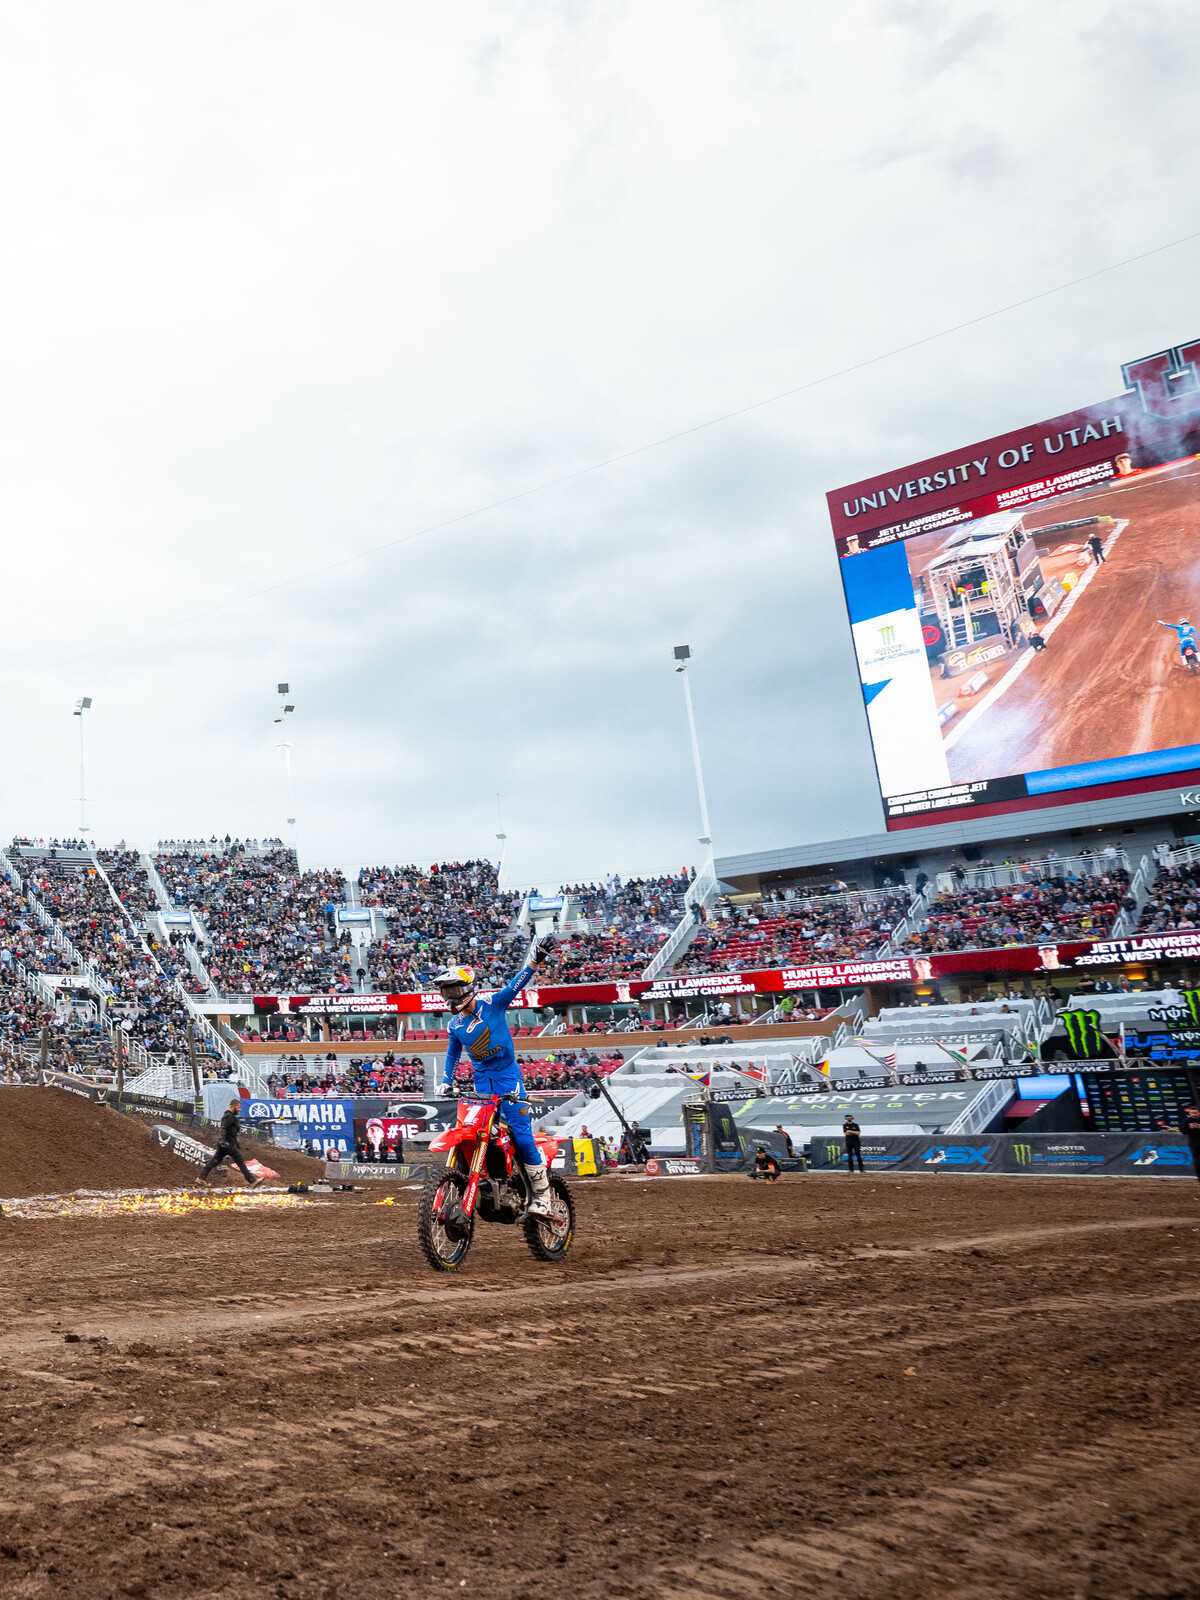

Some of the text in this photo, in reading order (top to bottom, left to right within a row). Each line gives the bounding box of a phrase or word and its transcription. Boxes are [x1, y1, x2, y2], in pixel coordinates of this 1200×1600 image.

[843, 414, 1124, 517] UNIVERSITY OF UTAH
[997, 462, 1112, 502] HUNTER LAWRENCE
[998, 469, 1114, 508] 250SX EAST CHAMPION
[878, 507, 960, 538] JETT LAWRENCE
[897, 526, 921, 542] WEST
[921, 511, 973, 534] CHAMPION
[1090, 941, 1129, 954] JETT
[1074, 954, 1120, 966] 250SX
[1121, 950, 1163, 962] WEST
[782, 959, 910, 980] HUNTER LAWRENCE
[60, 977, 72, 986] 41
[513, 971, 529, 992] HONDA
[651, 975, 742, 991] JETT LAWRENCE
[783, 970, 912, 990] 250SX EAST CHAMPION
[421, 994, 446, 1003] HUN
[641, 984, 755, 1000] 250SX WEST CHAMPION
[299, 1003, 398, 1013] 250SX WEST CHAMPION
[308, 995, 387, 1006] JETT LAWRENCE
[474, 1045, 503, 1061] HONDA
[767, 1090, 968, 1105] MONSTER
[135, 1106, 174, 1119] MONSTER
[270, 1104, 347, 1123] YAMAHA
[463, 1105, 482, 1123] 1
[788, 1102, 929, 1110] ENERGY
[174, 1140, 206, 1162] SPECIAL
[352, 1165, 396, 1175] MONSTER
[466, 1182, 477, 1212] DUNLOP
